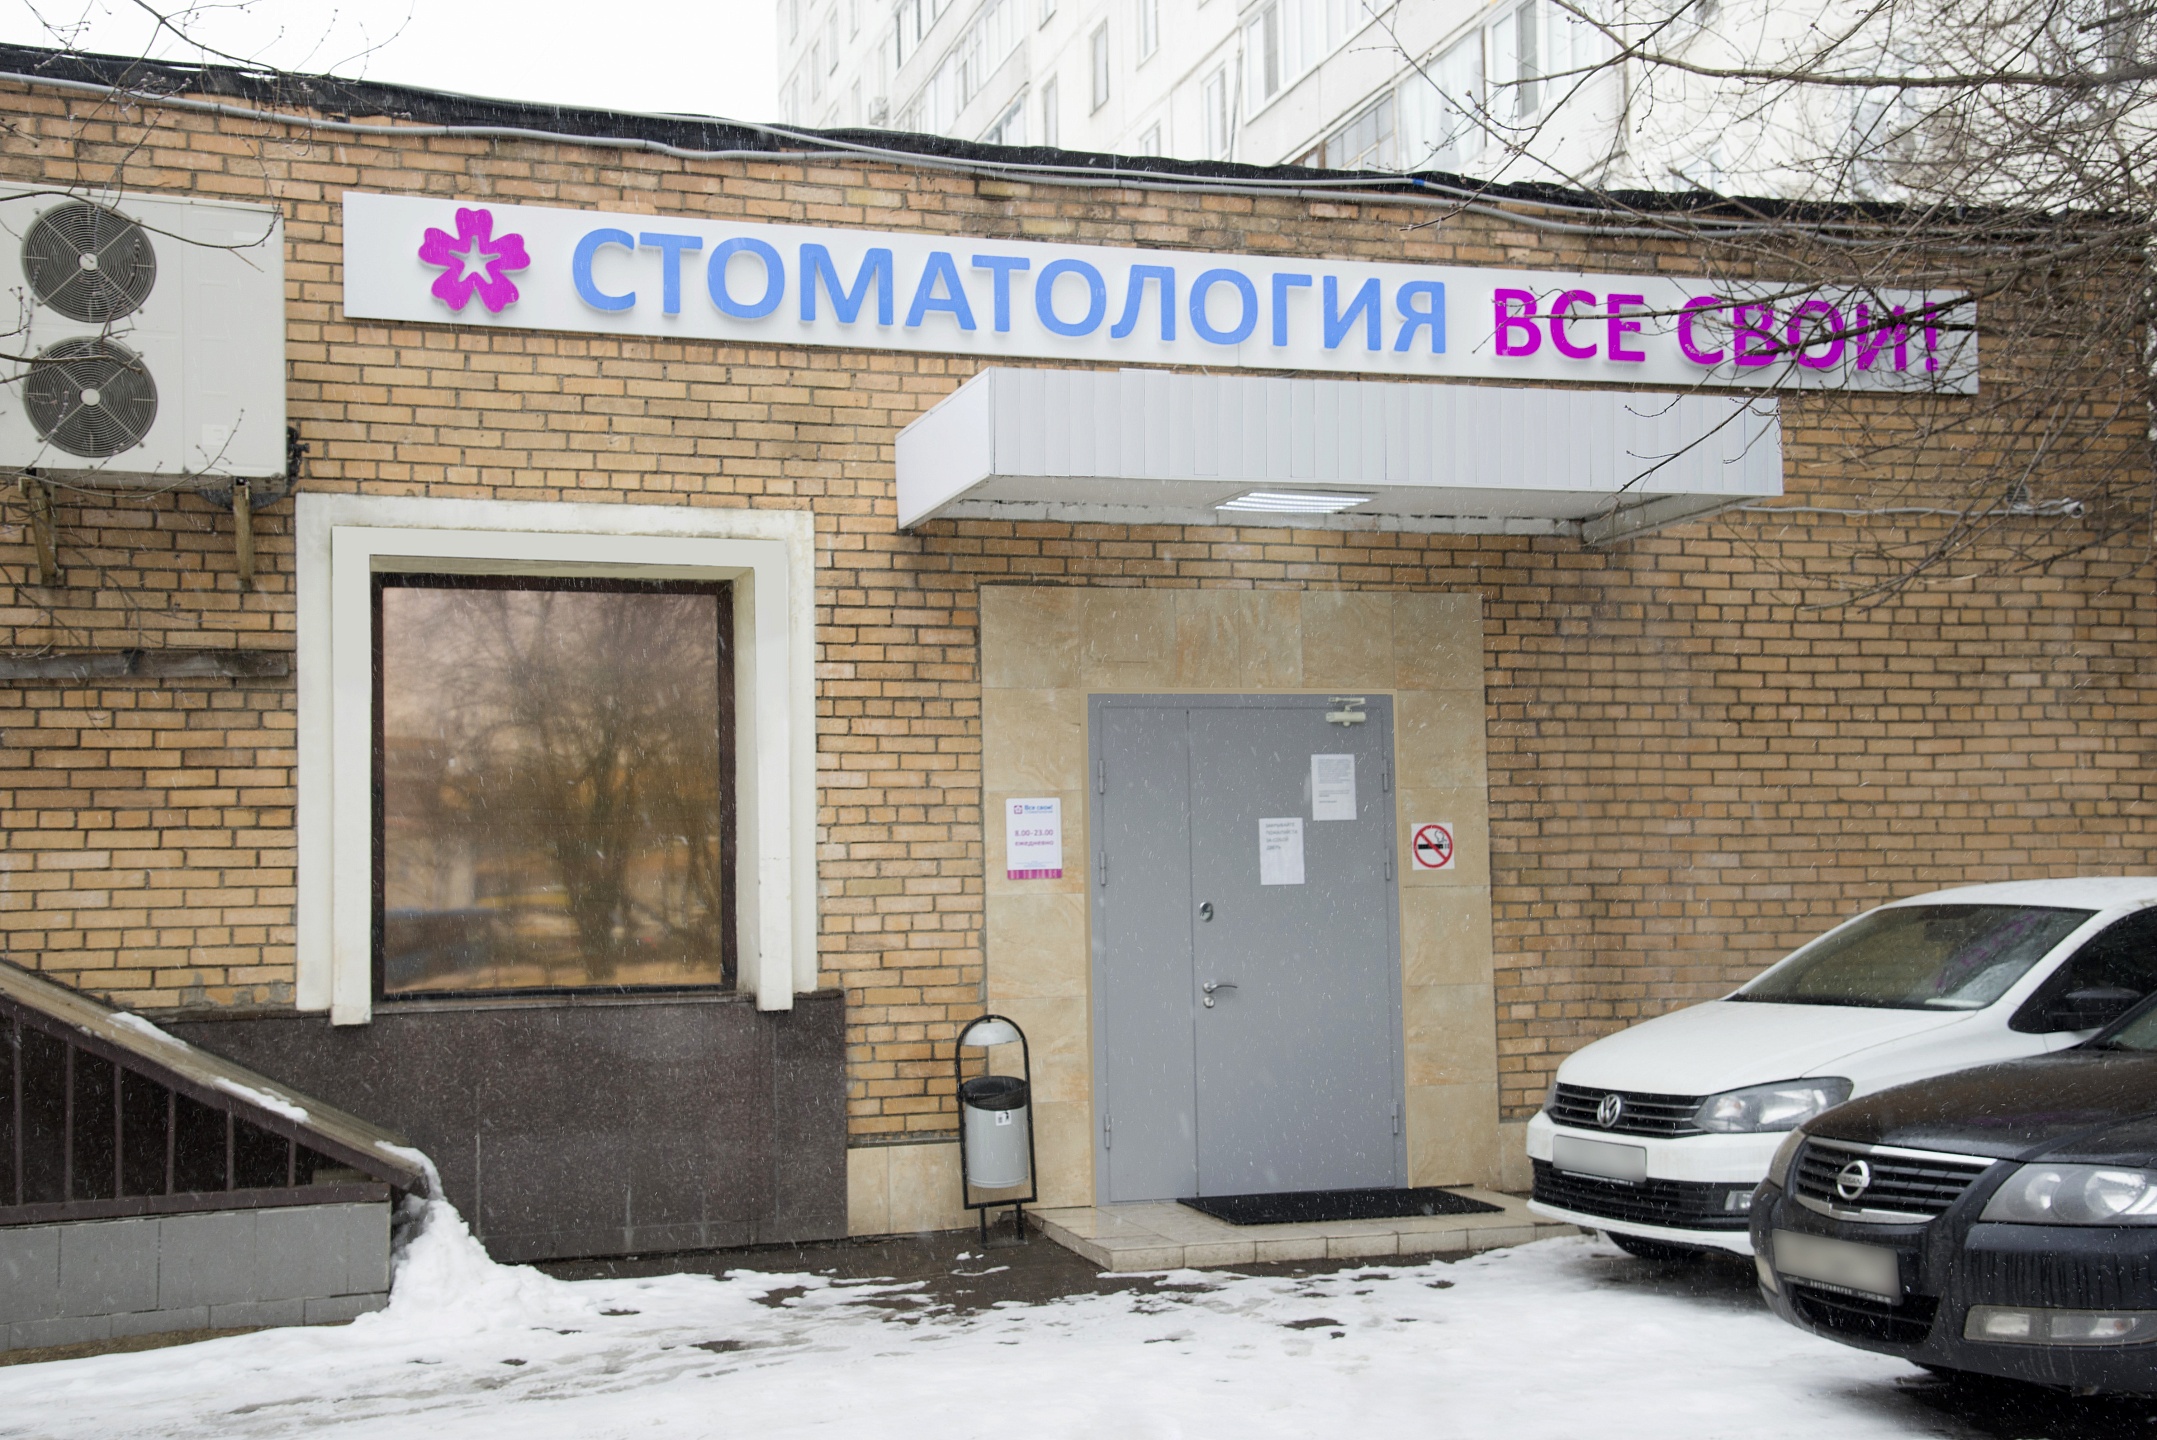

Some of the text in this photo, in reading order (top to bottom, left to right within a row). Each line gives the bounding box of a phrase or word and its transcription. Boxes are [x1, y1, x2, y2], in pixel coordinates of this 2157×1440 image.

[572, 228, 1939, 373] СТОМАТОЛОГИЯ ВСЕ СВОИ!
